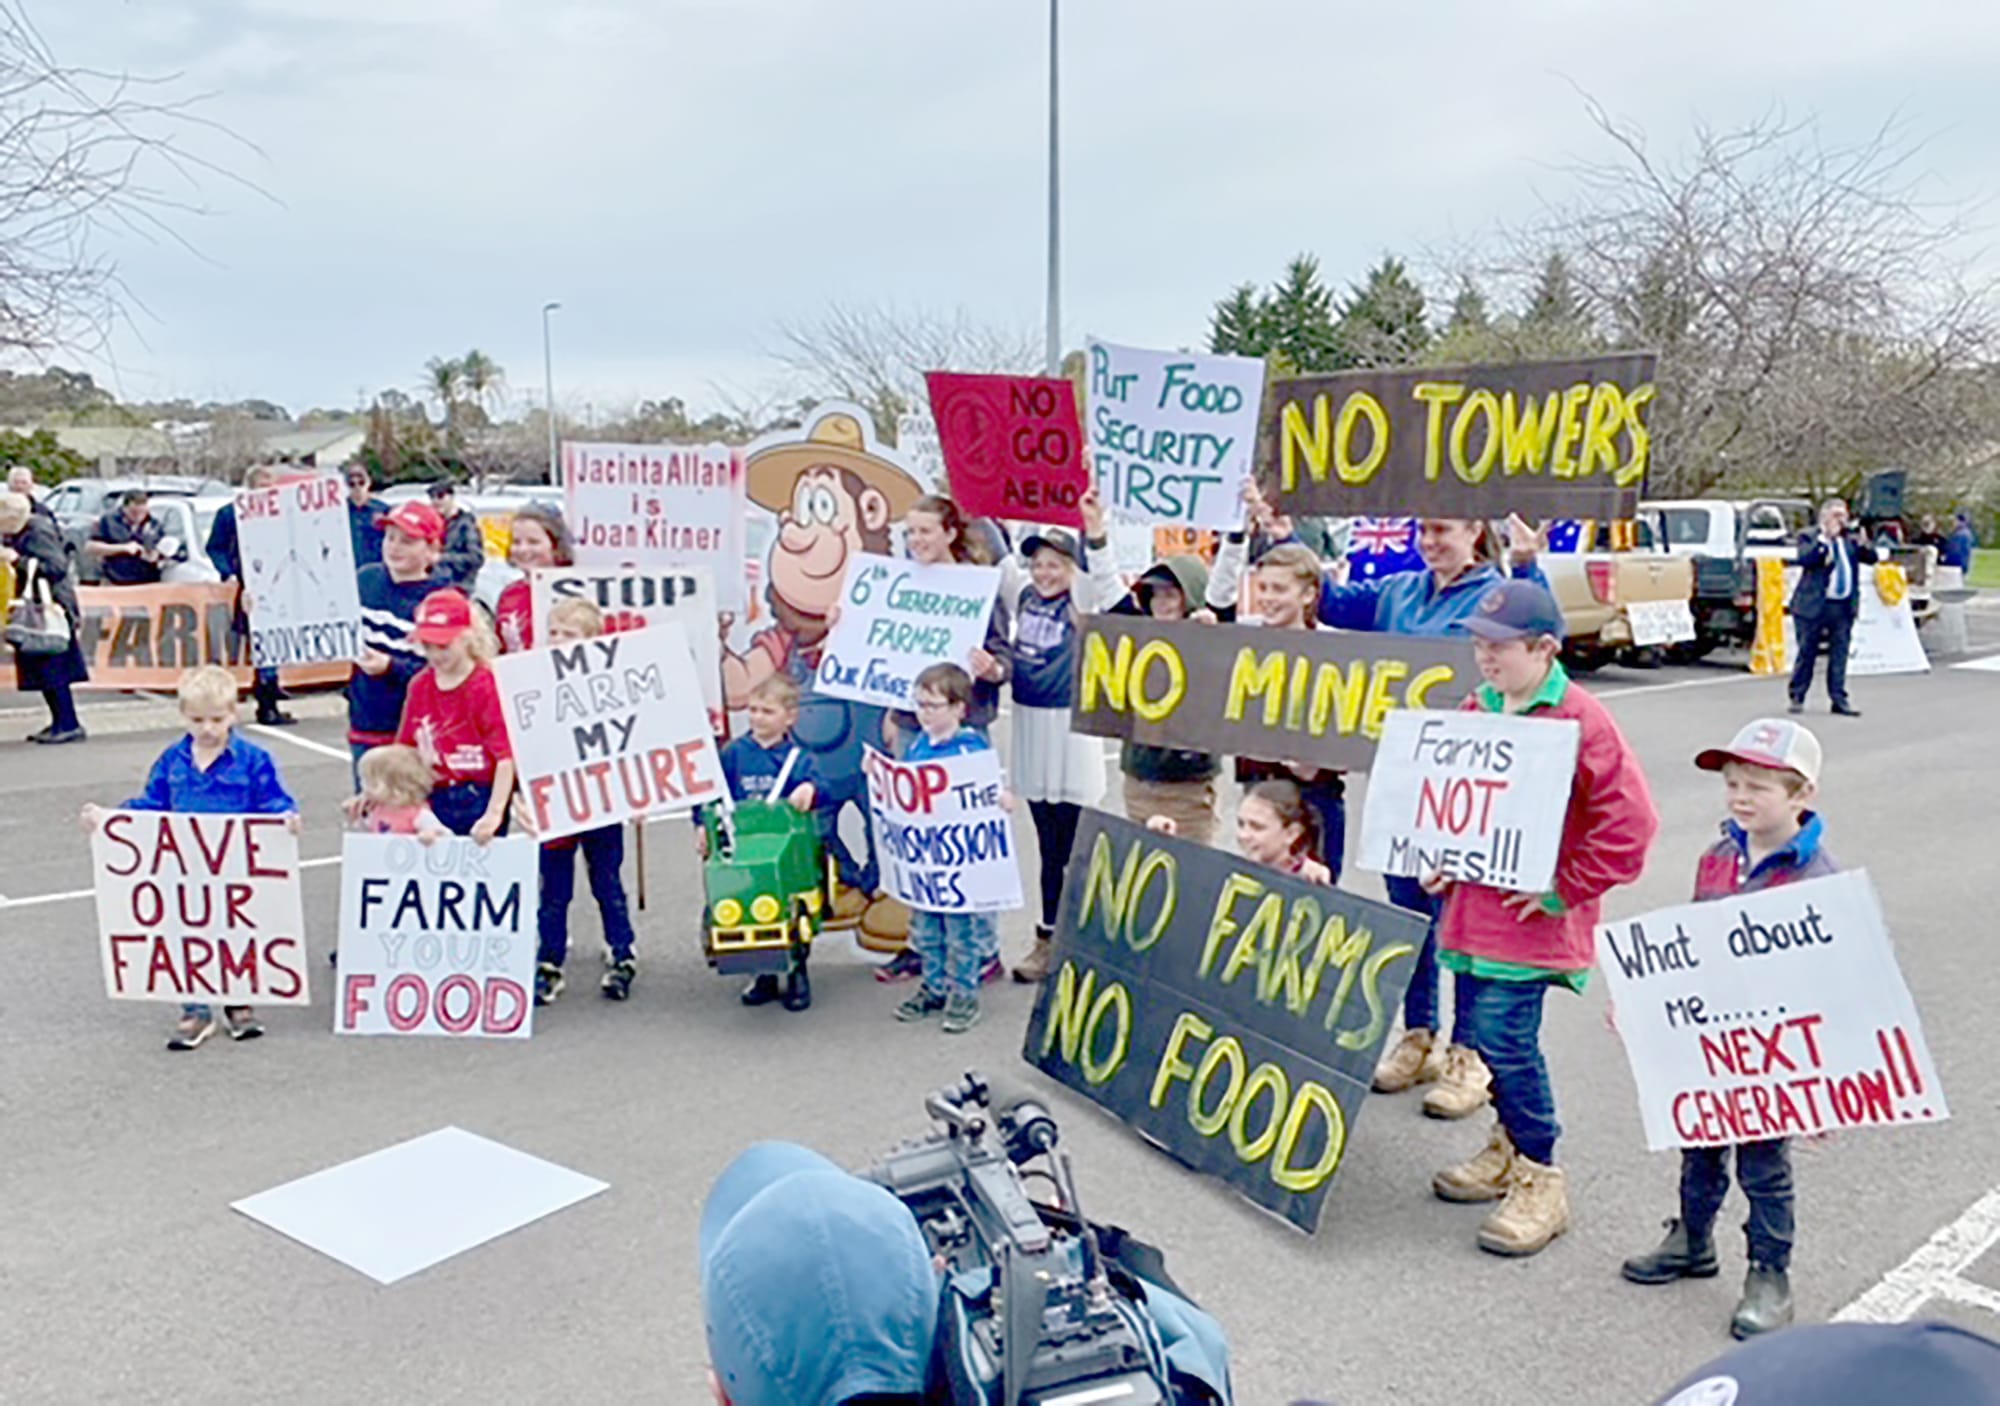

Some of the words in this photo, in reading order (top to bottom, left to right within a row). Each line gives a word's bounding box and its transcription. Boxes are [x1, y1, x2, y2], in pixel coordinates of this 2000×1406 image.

[1010, 384, 1056, 417] NO
[1091, 344, 1138, 402] PUT
[1157, 363, 1242, 414] FOOD
[1012, 426, 1068, 466] GO
[1094, 406, 1234, 469] SECURITY
[1279, 390, 1389, 491] NO
[1413, 381, 1655, 487] TOWERS
[236, 489, 280, 520] SAVE
[297, 479, 341, 512] OUR
[577, 451, 663, 484] Jacinta
[666, 453, 727, 486] Allan
[1095, 453, 1222, 521] FIRST
[578, 517, 638, 546] Joan
[645, 518, 721, 550] Kirner
[632, 494, 661, 515] is
[551, 576, 697, 608] STOP
[551, 637, 620, 681] MY
[1079, 631, 1186, 721] NO
[513, 663, 666, 730] FARM
[573, 714, 637, 762] MY
[529, 738, 715, 832] FUTURE
[870, 751, 950, 814] STOP
[951, 781, 999, 811] THE
[1414, 777, 1509, 836] NOT
[104, 814, 290, 879] SAVE
[384, 838, 492, 878] OUR
[132, 880, 258, 929] OUR
[360, 878, 521, 932] FARM
[893, 862, 967, 908] LINES
[110, 935, 302, 999] FARMS
[378, 932, 513, 972] YOUR
[1077, 831, 1178, 952] NO
[1197, 872, 1415, 1051] FARMS
[1605, 922, 1700, 980] What
[1728, 905, 1833, 958] about
[342, 973, 529, 1035] FOOD
[1040, 960, 1133, 1085] NO
[1149, 1012, 1345, 1193] FOOD
[1699, 1014, 1824, 1077] NEXT
[1671, 1026, 1933, 1143] GENERATION!!
